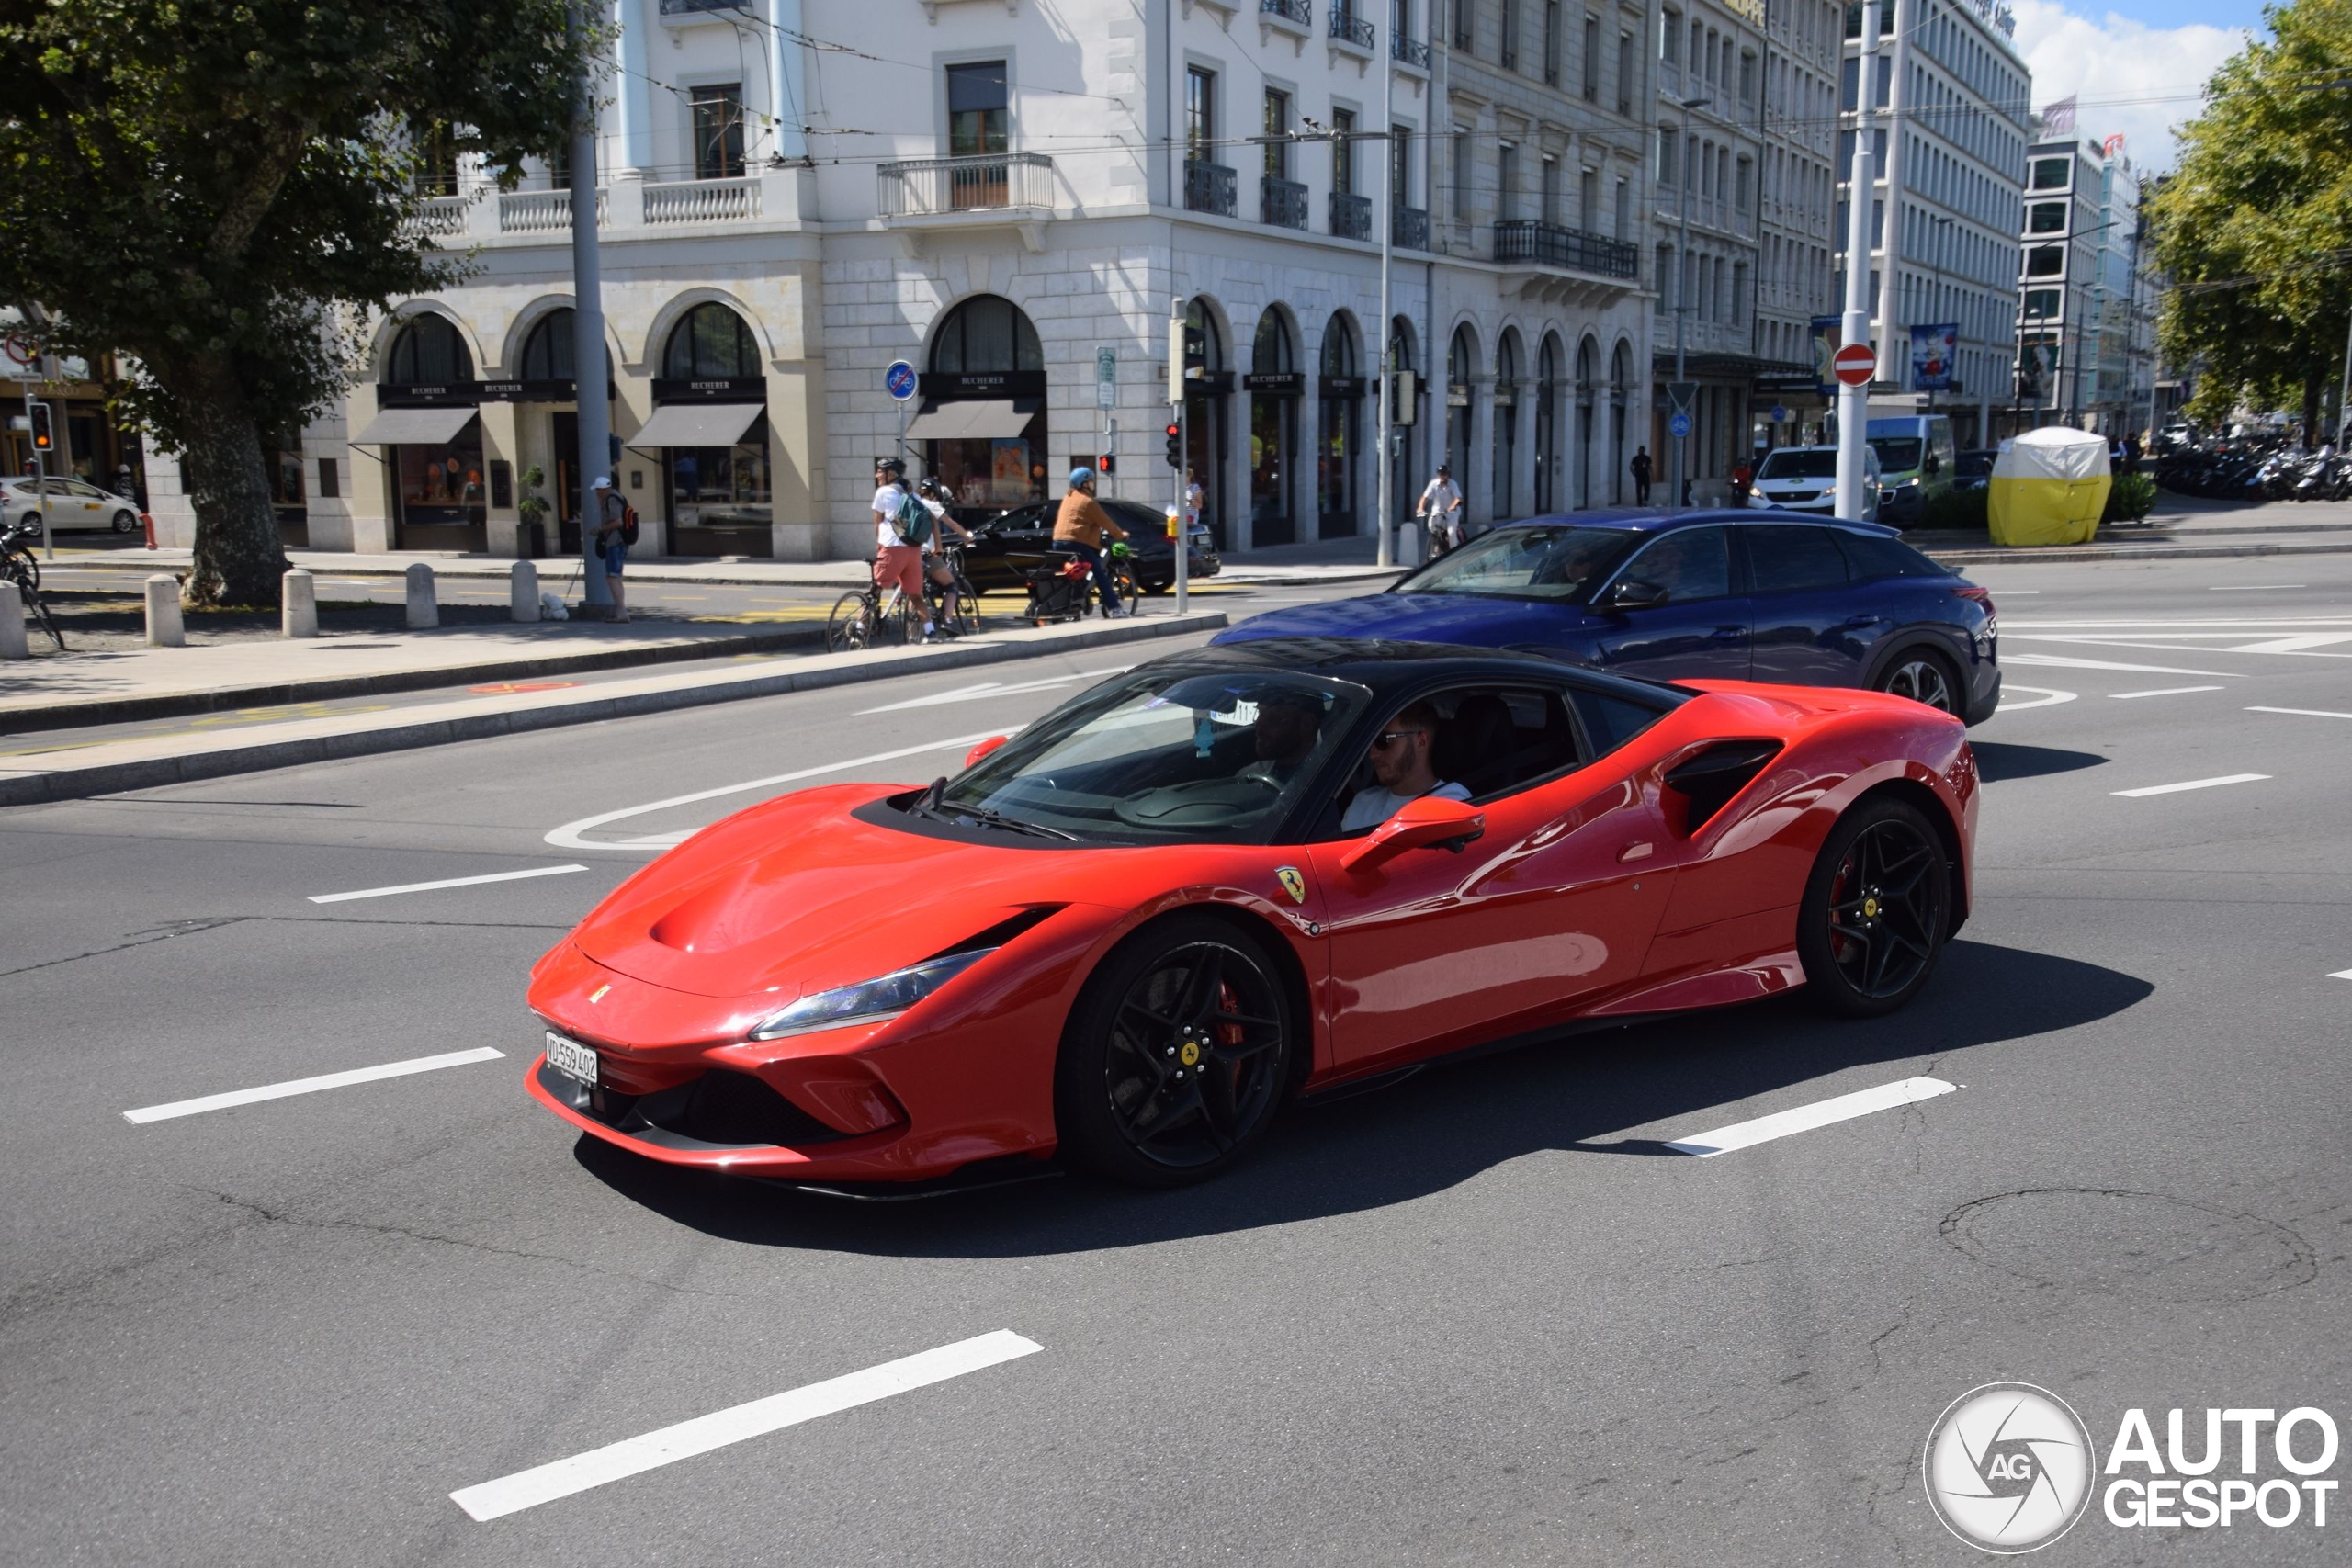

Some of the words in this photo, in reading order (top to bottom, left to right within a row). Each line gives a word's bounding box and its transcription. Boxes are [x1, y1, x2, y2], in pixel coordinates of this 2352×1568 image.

[961, 376, 1004, 385] BUCHERER
[1250, 375, 1293, 383] BUCHERER
[485, 384, 523, 392] BUCHERER
[691, 381, 729, 389] BUCHERER
[412, 387, 447, 395] BUCHERER
[578, 1051, 596, 1080] 402
